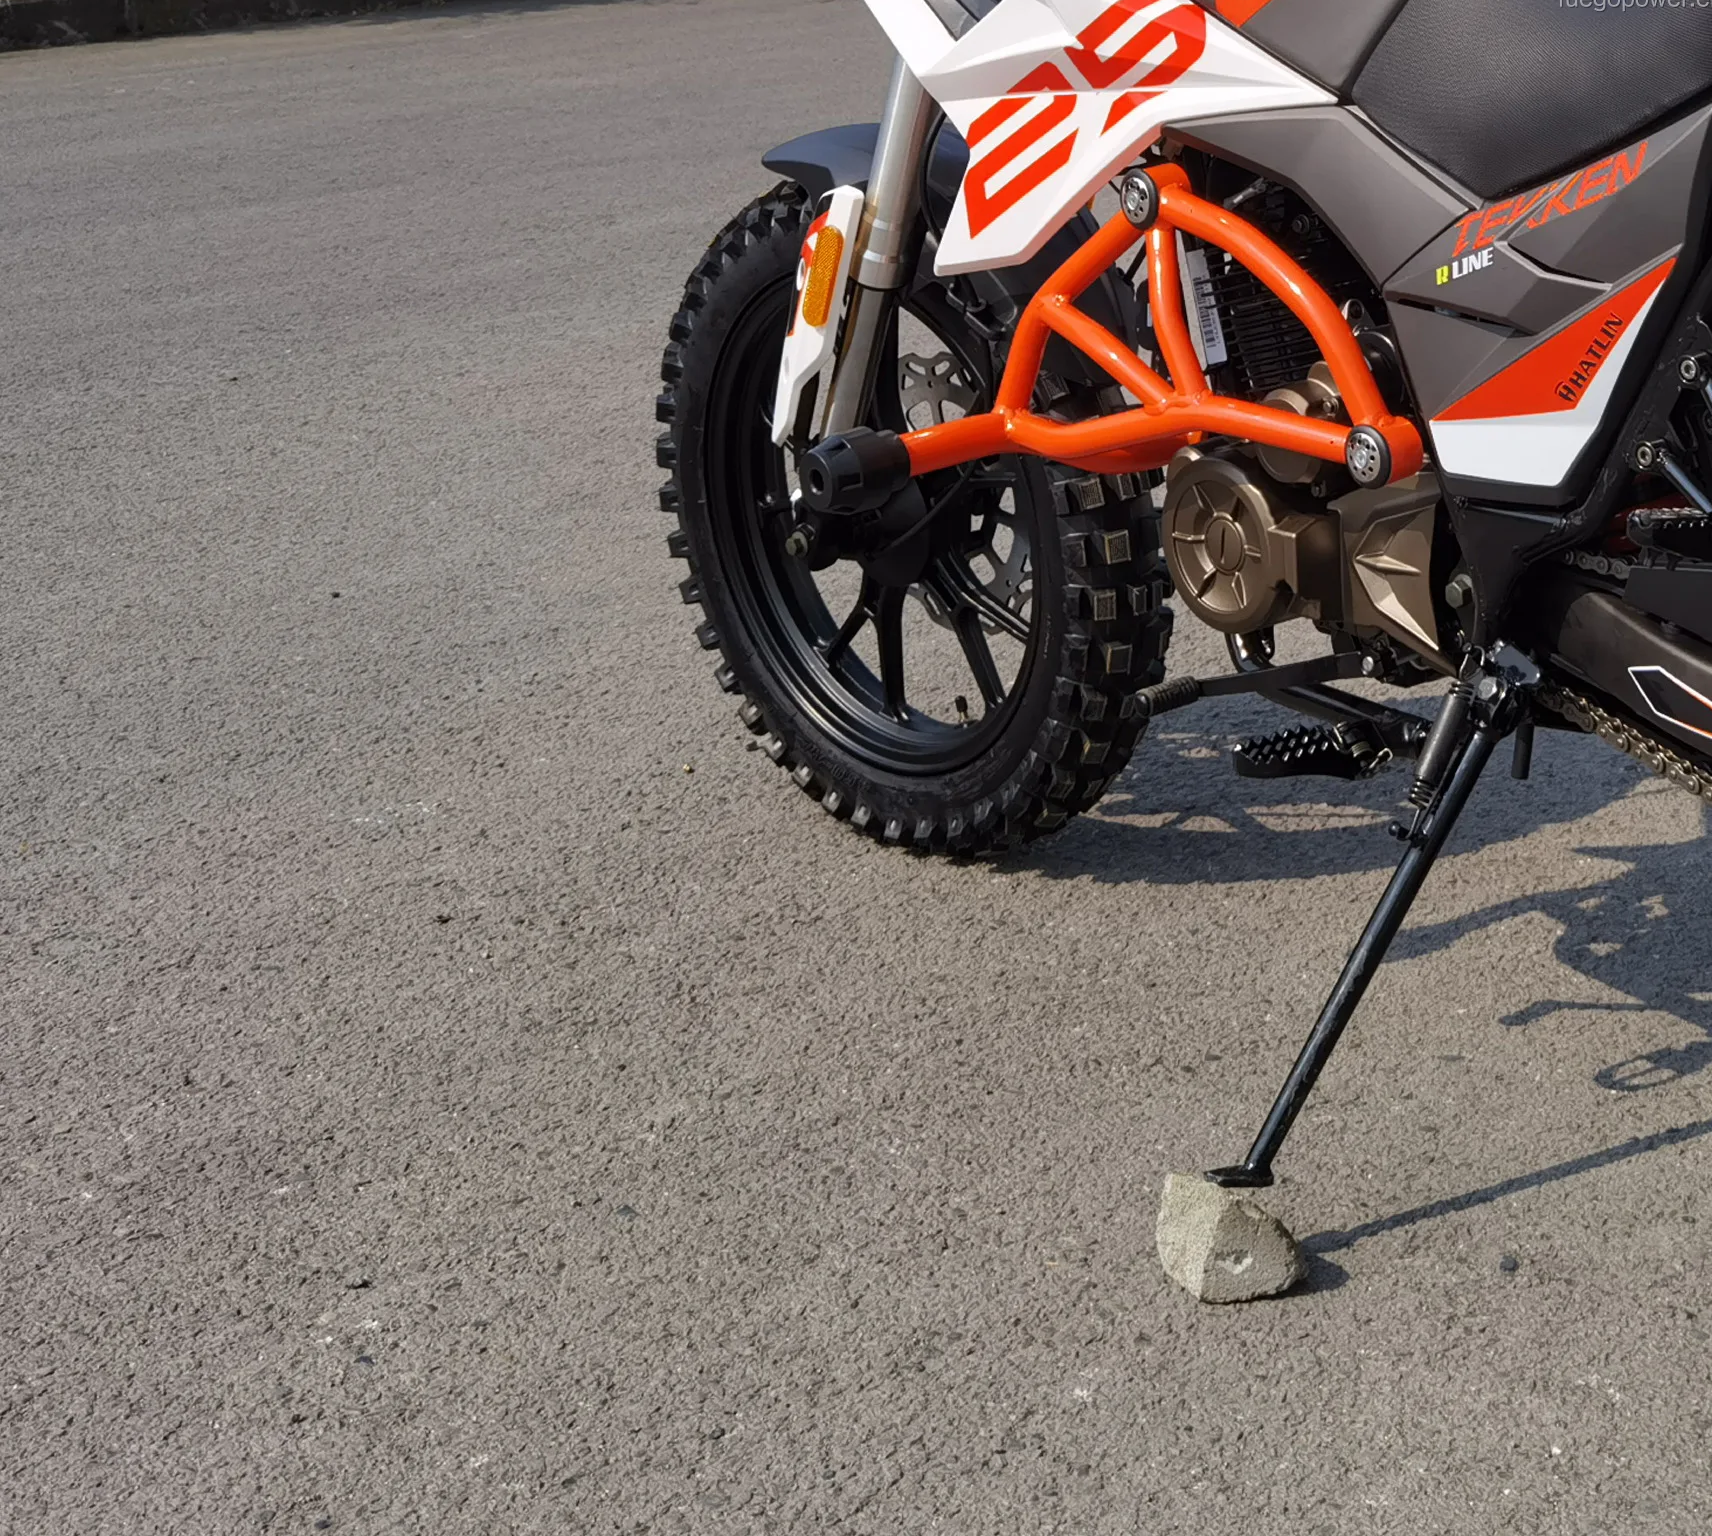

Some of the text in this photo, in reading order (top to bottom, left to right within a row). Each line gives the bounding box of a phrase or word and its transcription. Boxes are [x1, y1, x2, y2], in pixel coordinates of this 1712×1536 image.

[1451, 141, 1648, 257] TEKKEN
[1436, 247, 1494, 285] R LINE
[1569, 312, 1624, 389] HATLIN
